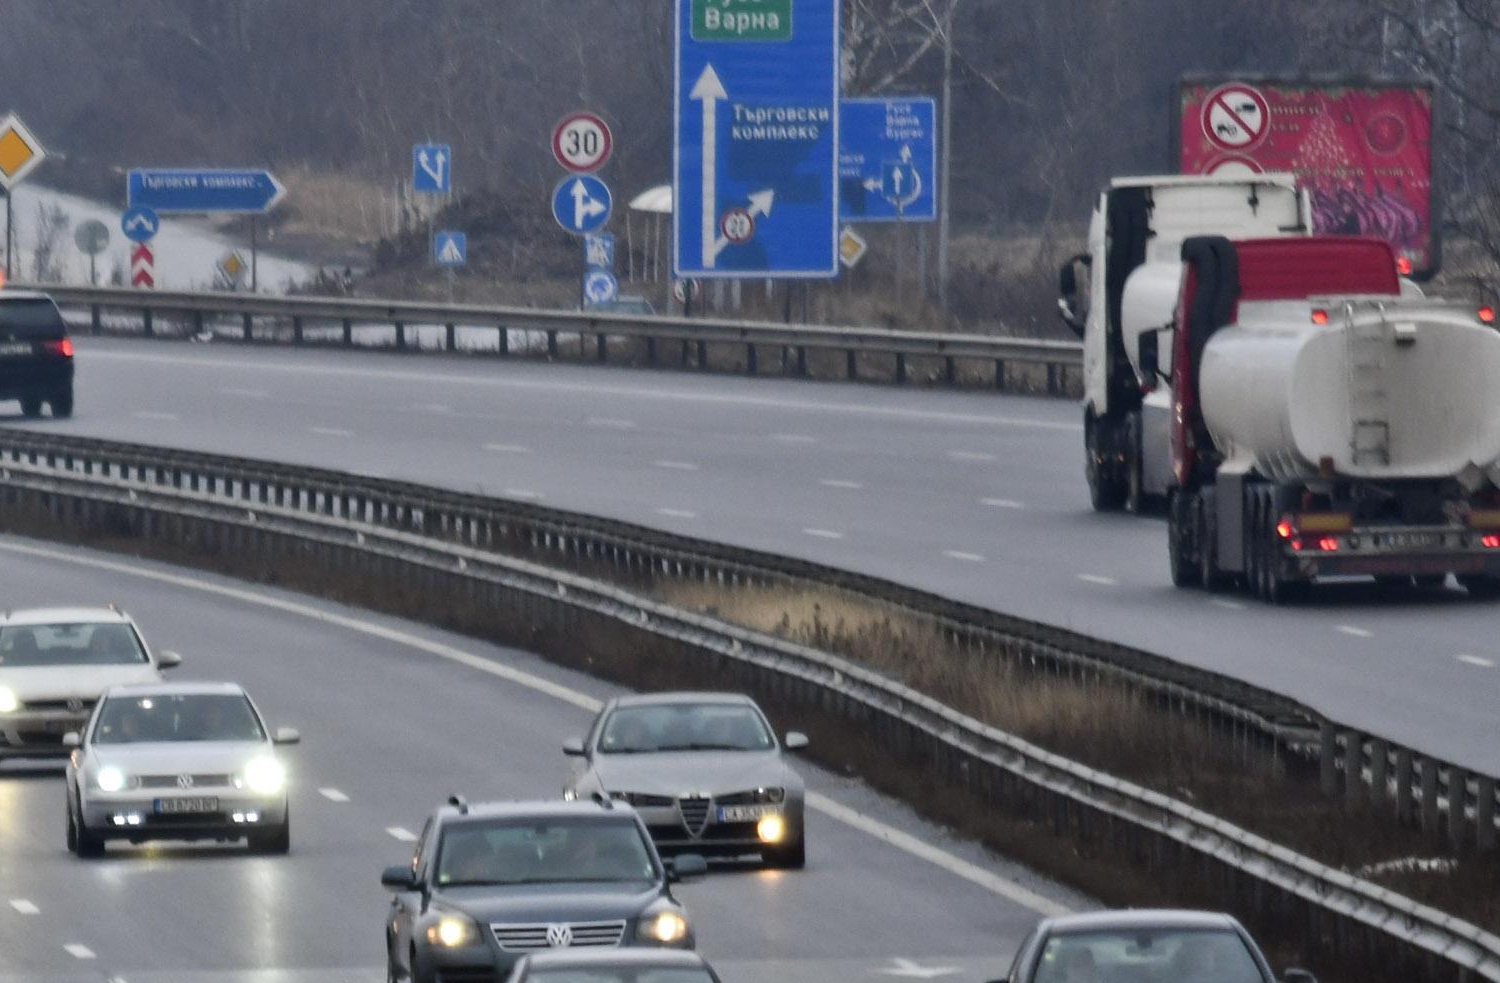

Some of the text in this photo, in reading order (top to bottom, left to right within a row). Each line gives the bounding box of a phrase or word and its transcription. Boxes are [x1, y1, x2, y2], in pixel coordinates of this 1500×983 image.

[705, 7, 780, 34] Варна
[733, 104, 830, 125] Търговски
[566, 130, 598, 157] 30
[732, 125, 819, 140] комплекс
